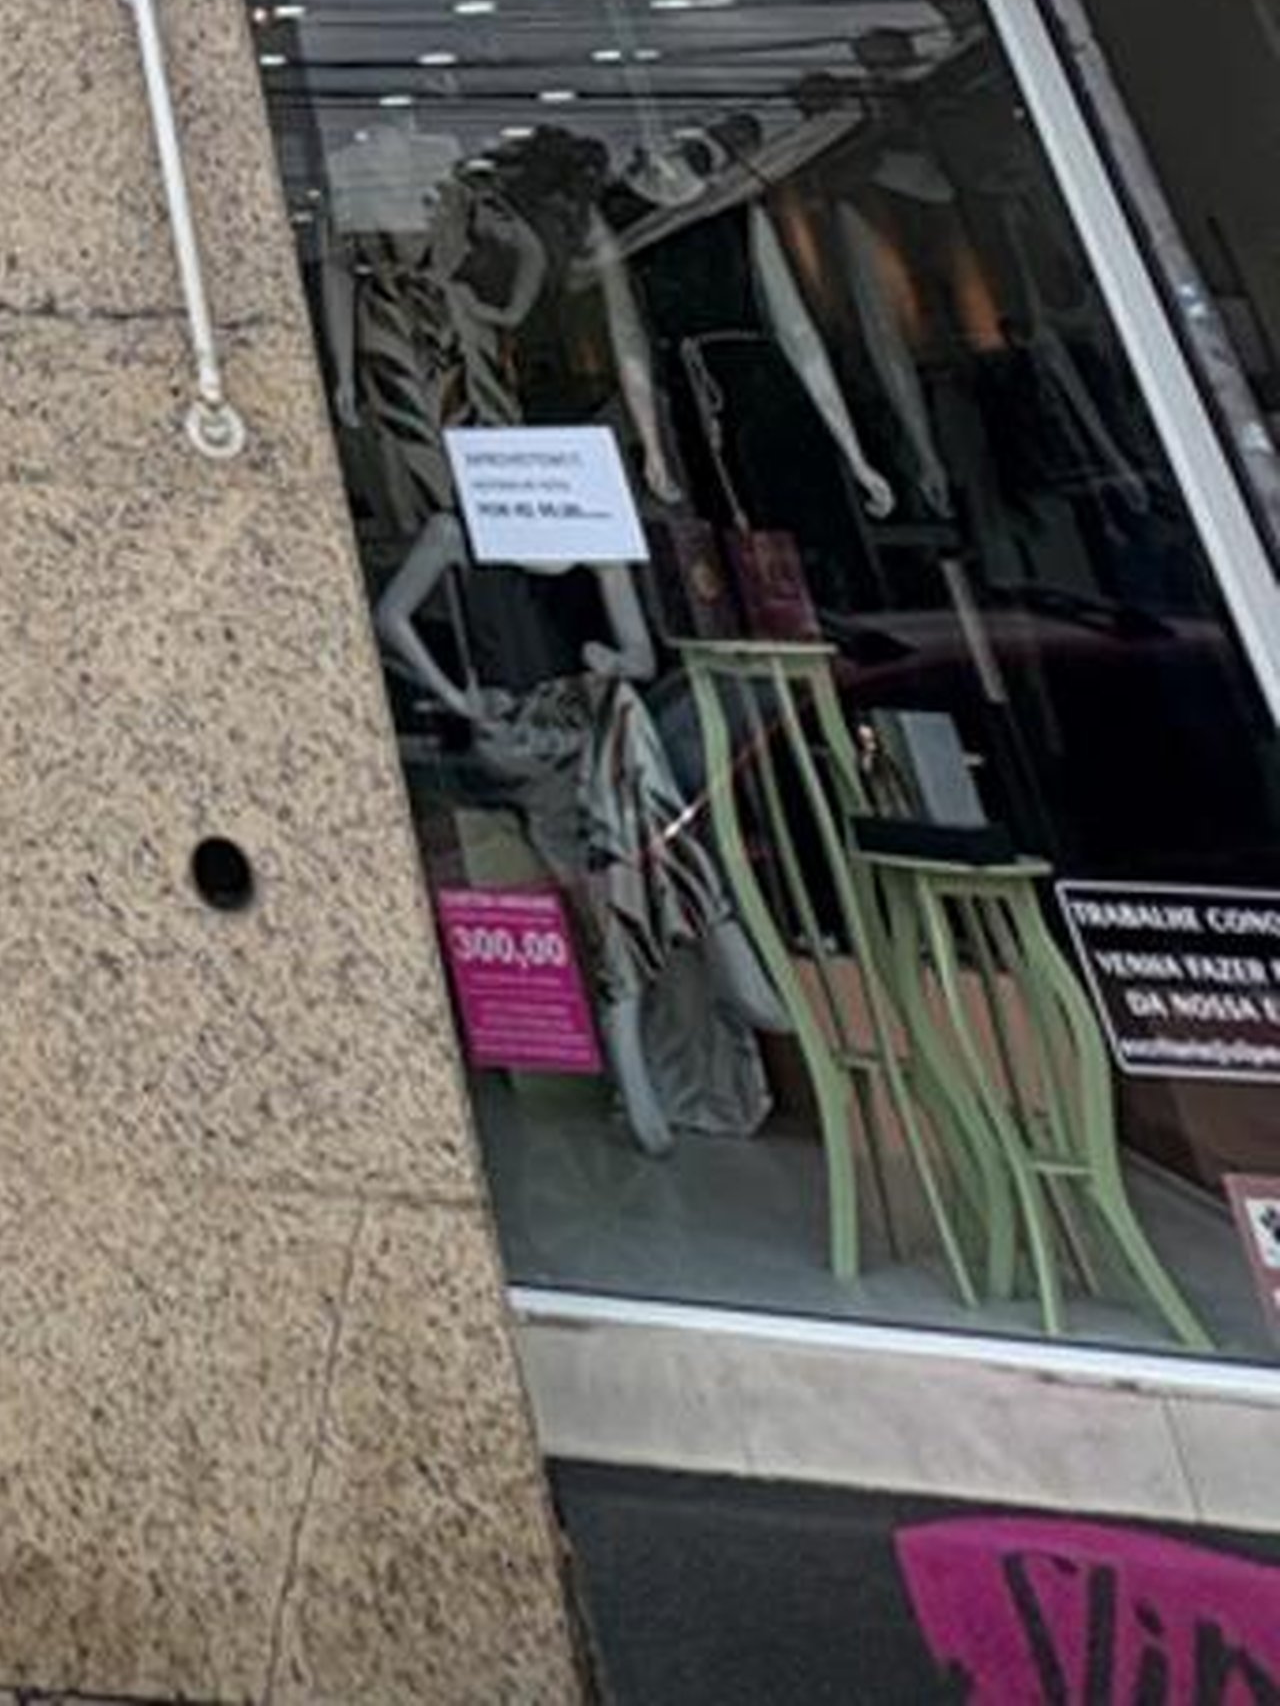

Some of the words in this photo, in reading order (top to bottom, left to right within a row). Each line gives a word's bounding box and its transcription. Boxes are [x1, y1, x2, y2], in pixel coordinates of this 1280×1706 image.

[1069, 901, 1203, 932] TRABALHE
[452, 924, 568, 969] 300,00
[1169, 992, 1261, 1021] NOSSA
